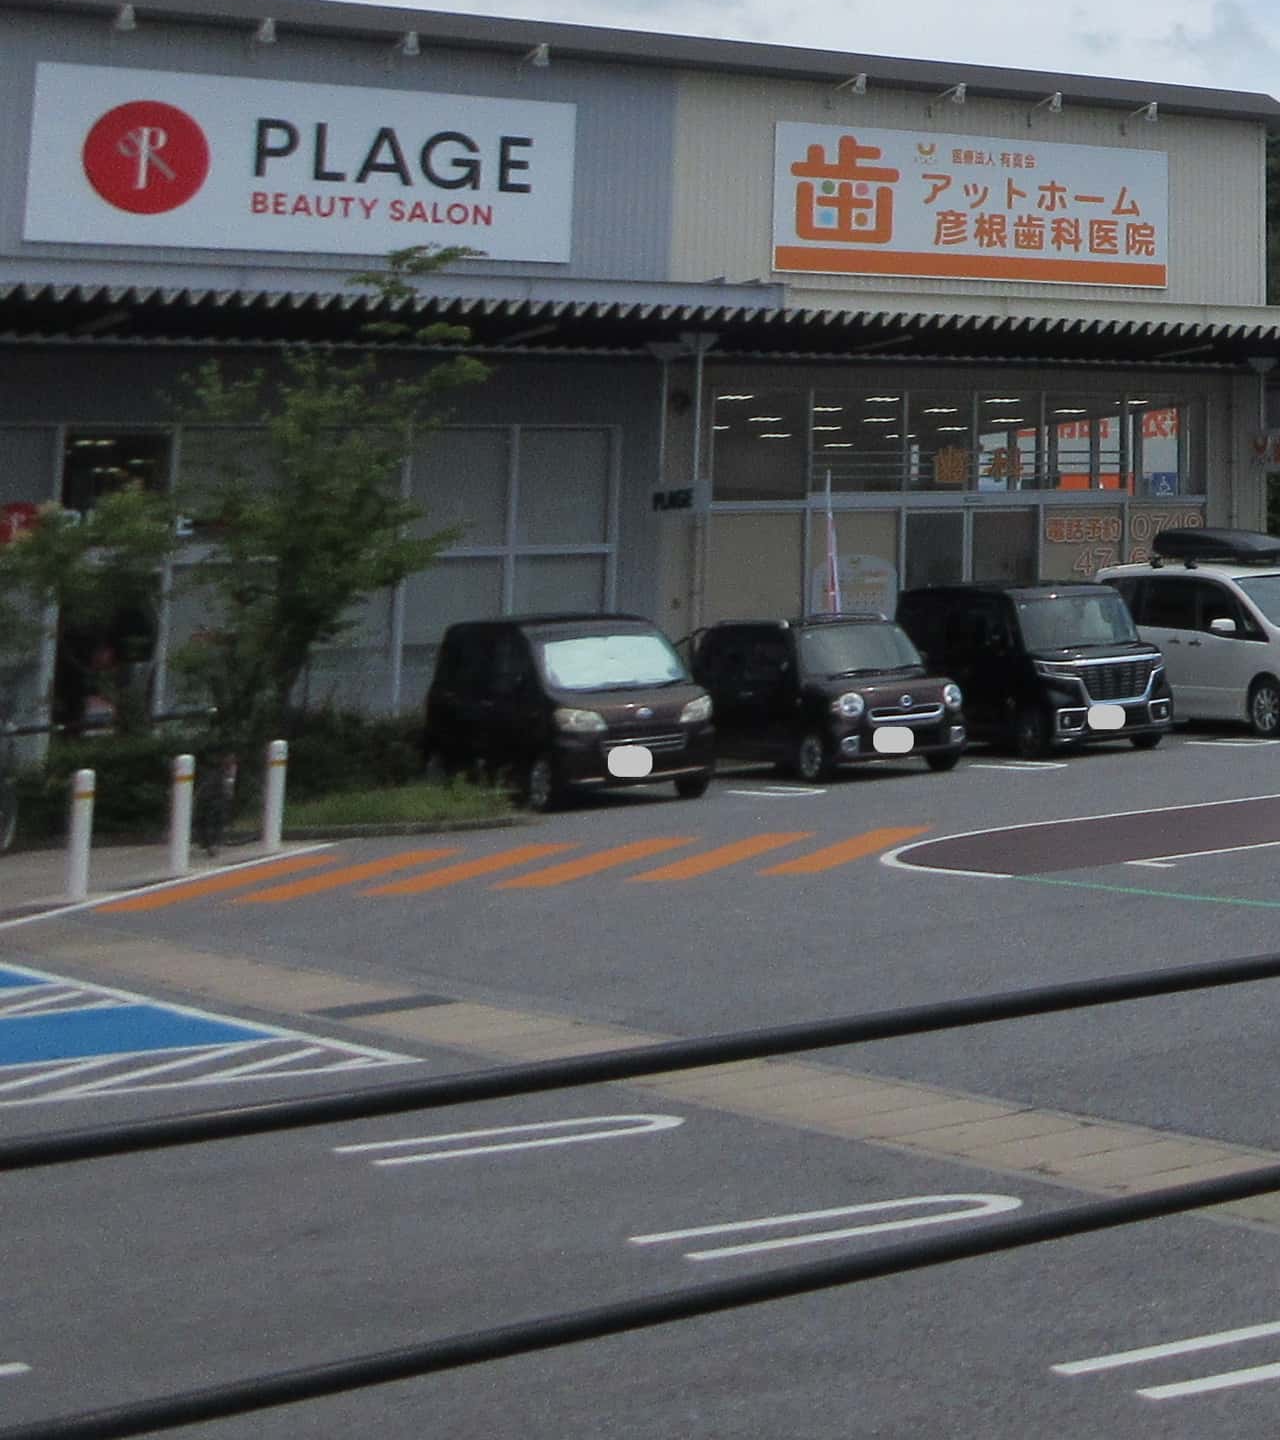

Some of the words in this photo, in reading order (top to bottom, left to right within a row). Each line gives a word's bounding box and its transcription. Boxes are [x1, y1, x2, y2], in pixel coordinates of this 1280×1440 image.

[253, 117, 534, 194] PLAGE
[250, 192, 378, 222] BEAUTY
[389, 199, 493, 227] SALON
[920, 173, 1141, 217] アットホーム
[933, 209, 1156, 257] 彦根歯科医院
